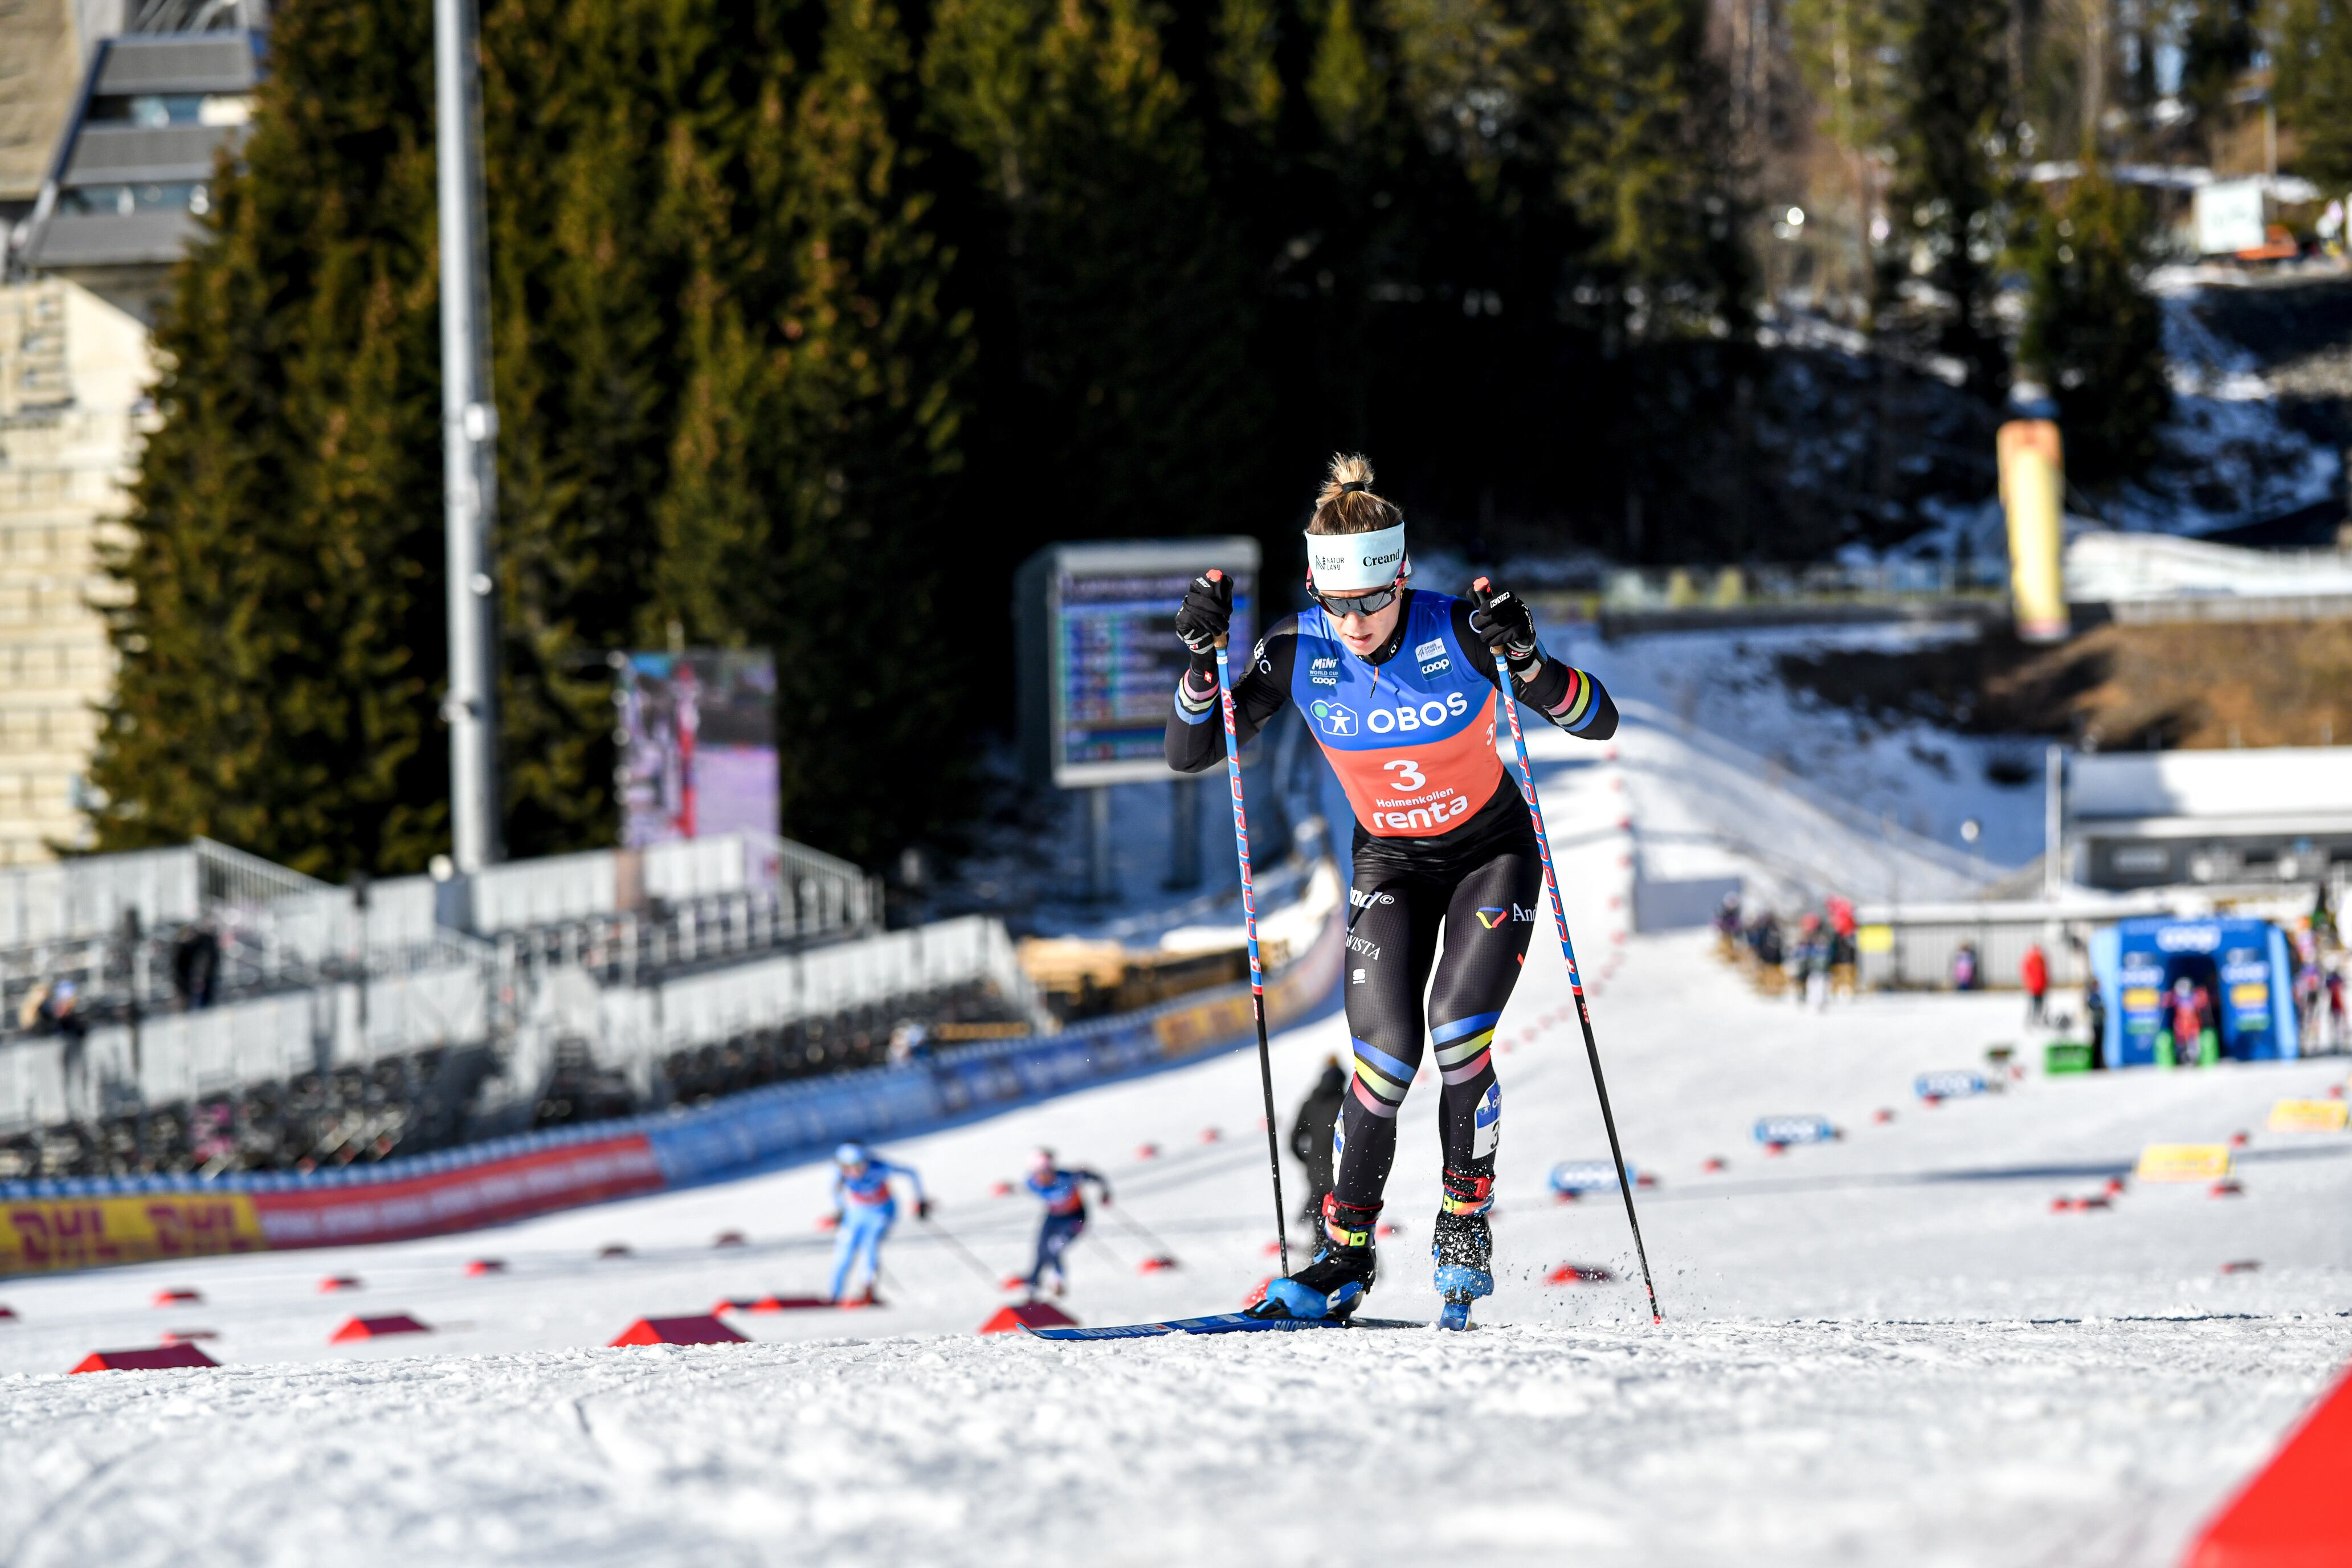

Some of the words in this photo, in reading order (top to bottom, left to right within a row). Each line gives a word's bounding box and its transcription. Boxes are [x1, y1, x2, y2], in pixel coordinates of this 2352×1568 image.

[1363, 549, 1400, 566] Creand
[1422, 659, 1449, 674] coop
[1312, 677, 1337, 686] coop
[1367, 692, 1468, 733] OBOS
[1486, 722, 1494, 746] 3
[1383, 760, 1426, 791] 3
[1375, 787, 1454, 808] Holmenkollen
[1373, 795, 1468, 828] renta
[1491, 1120, 1500, 1149] 3
[10, 1208, 119, 1264] DHL
[146, 1204, 250, 1252] DHL
